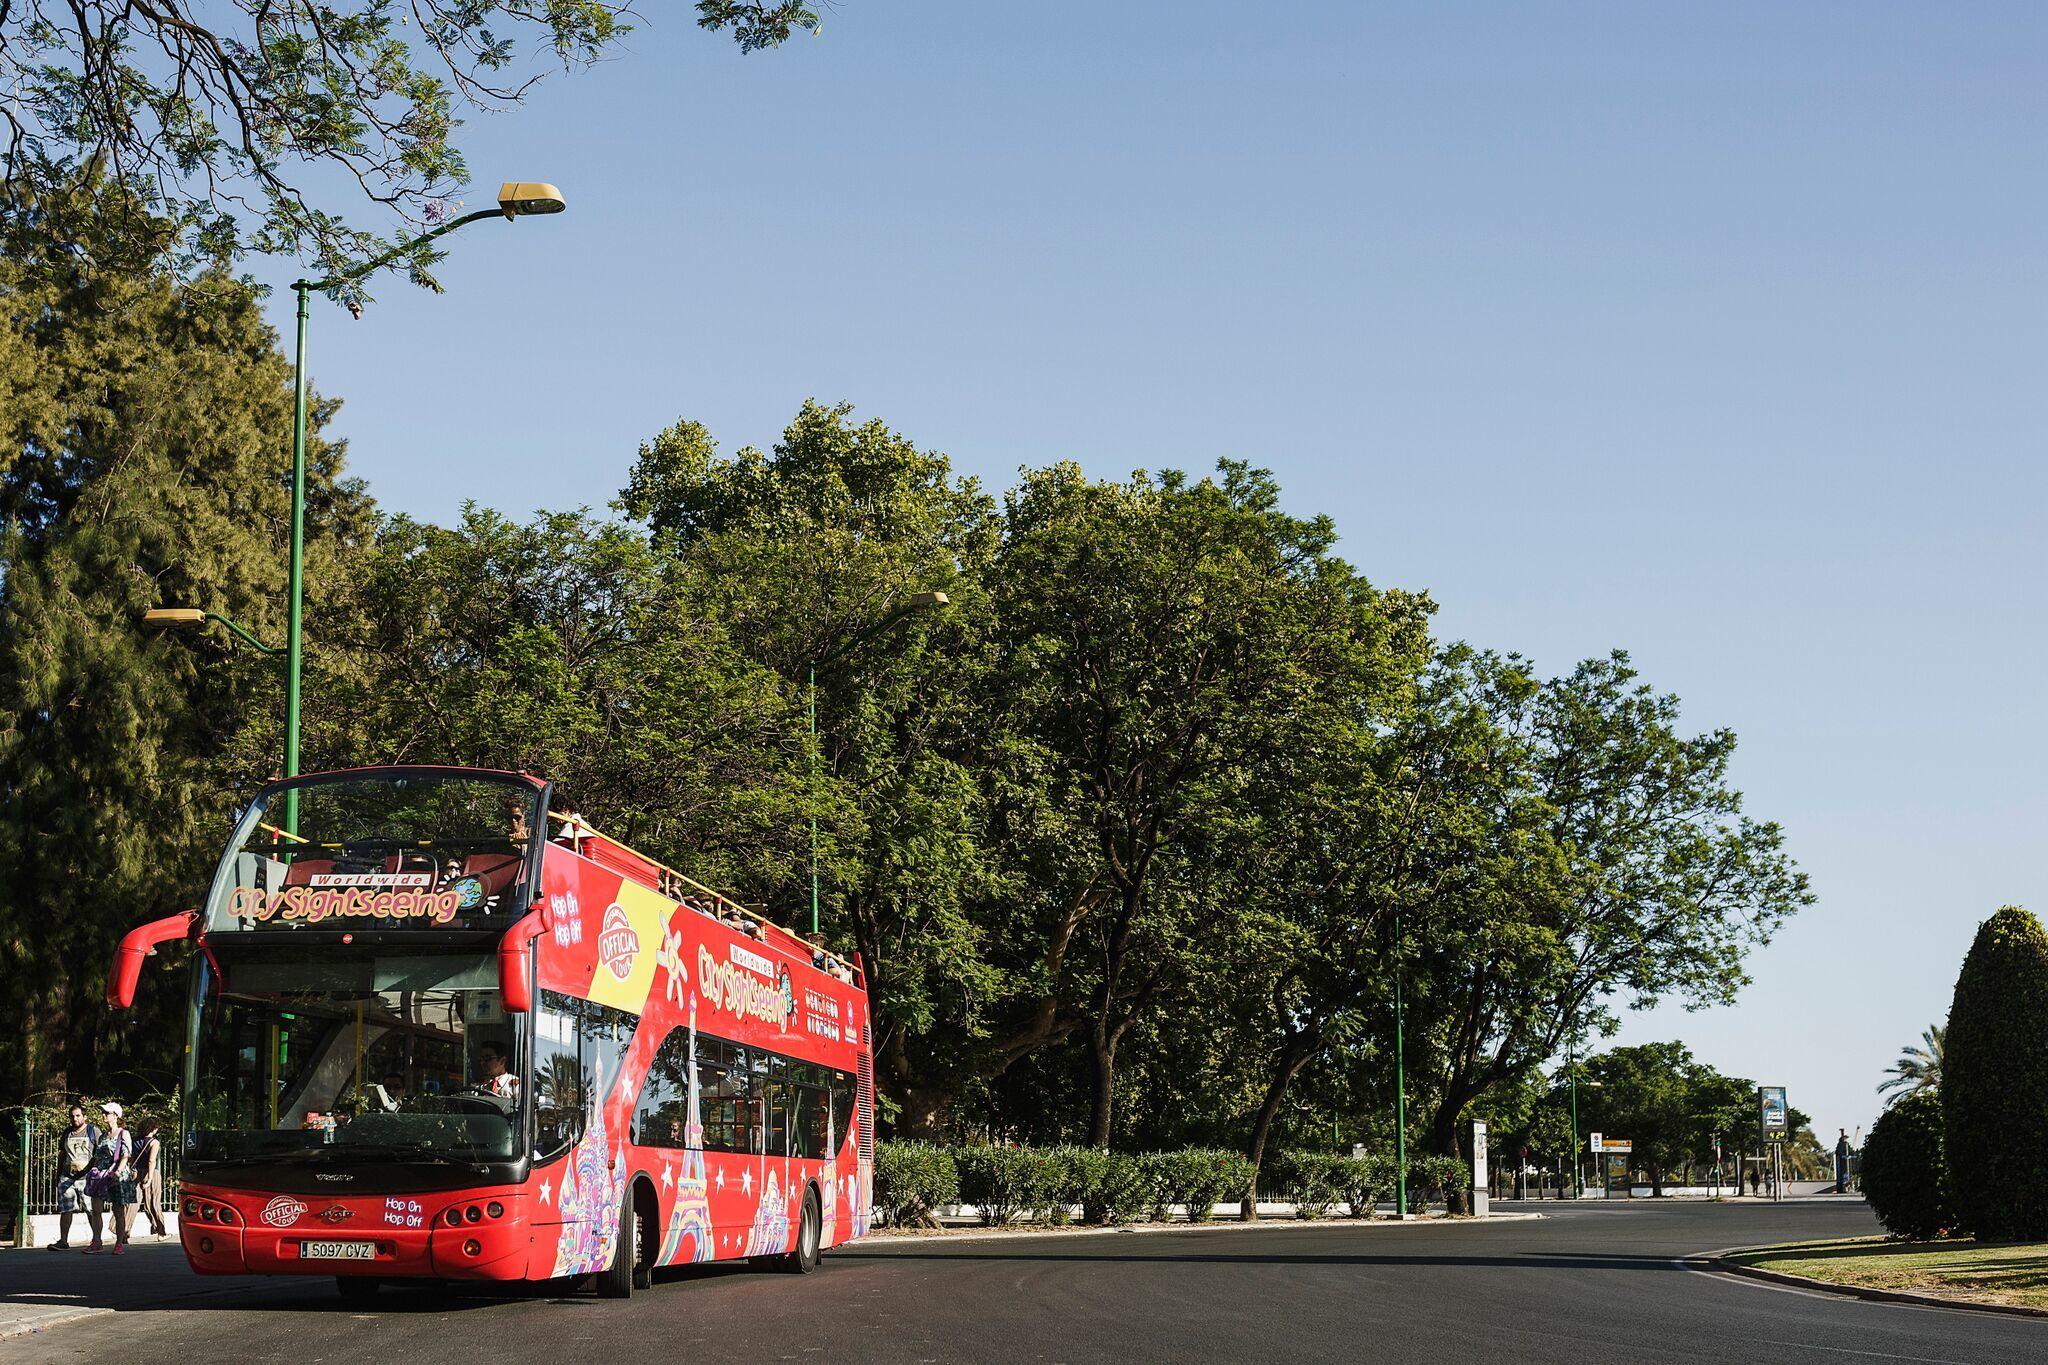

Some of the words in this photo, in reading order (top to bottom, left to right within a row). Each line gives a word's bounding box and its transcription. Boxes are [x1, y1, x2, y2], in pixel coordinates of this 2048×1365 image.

[317, 875, 423, 886] Worldwide
[550, 893, 567, 919] Hop
[566, 890, 579, 917] On
[554, 921, 570, 949] Hop
[570, 918, 582, 945] Off
[602, 931, 638, 961] OFFICIAL
[615, 958, 631, 977] TOUR
[265, 1203, 306, 1221] OFFICIAL
[385, 1197, 406, 1211] Hop
[408, 1200, 422, 1213] On
[277, 1214, 297, 1225] TOUR
[384, 1211, 404, 1226] Hop
[406, 1214, 423, 1228] Off
[313, 1243, 343, 1257] 5097
[346, 1244, 369, 1258] CVZ
